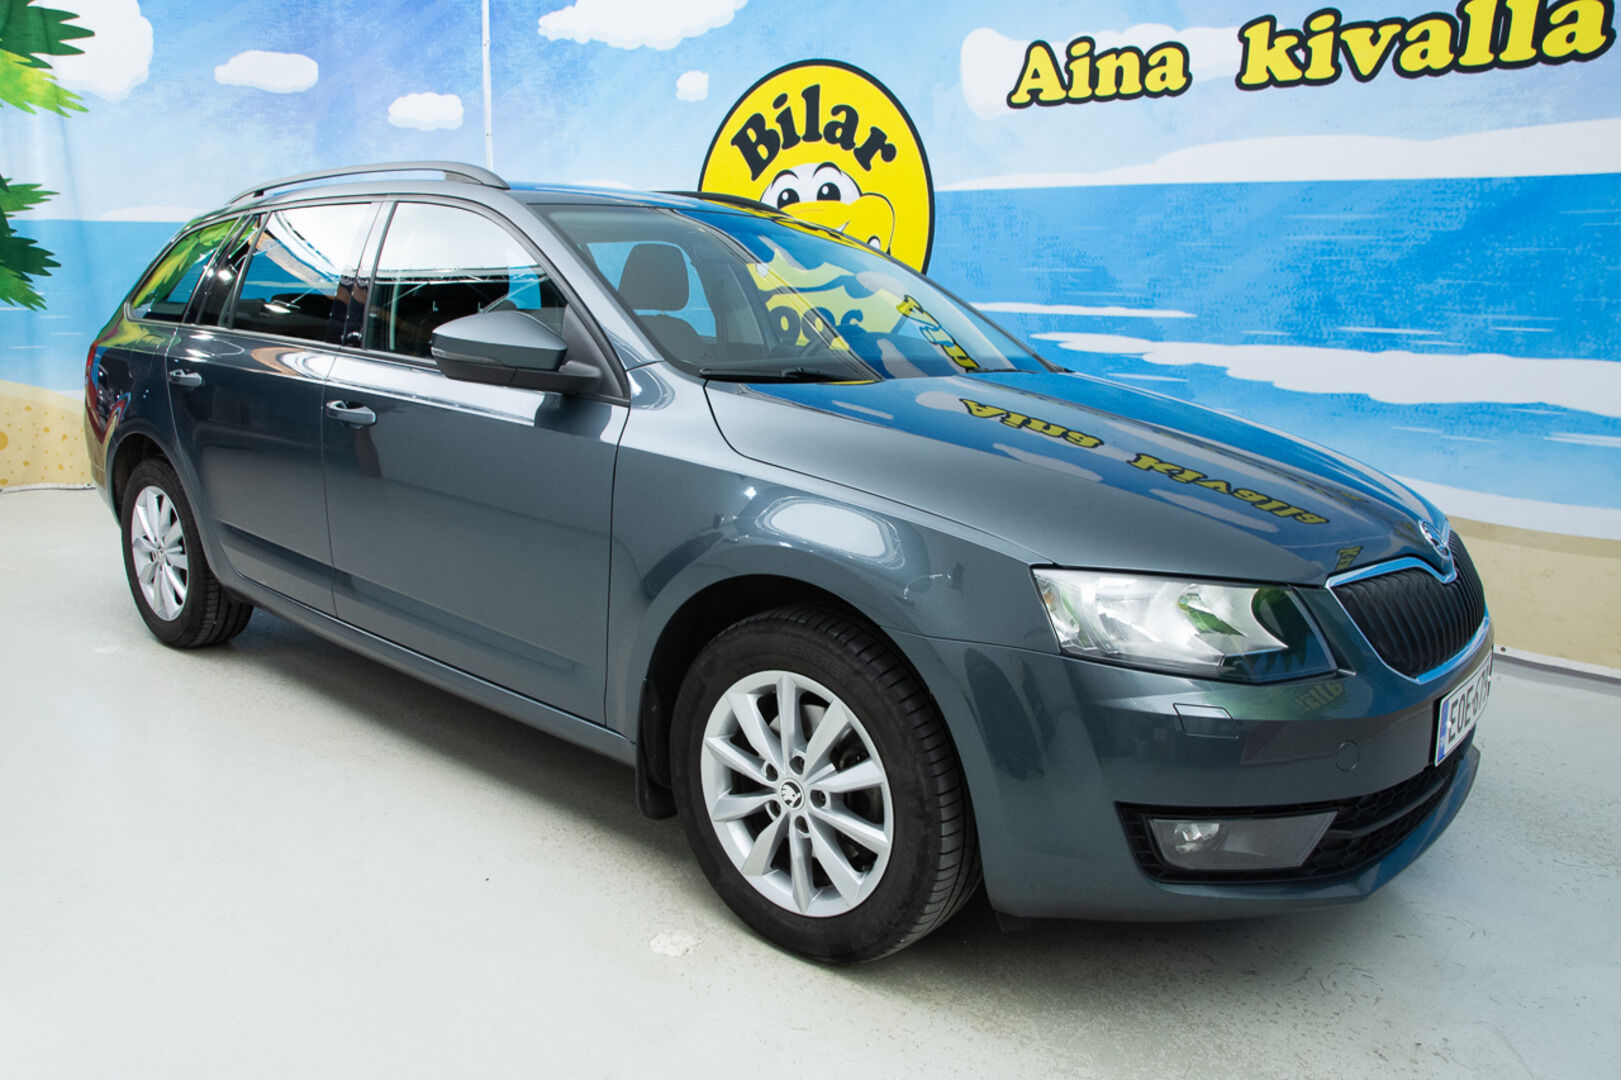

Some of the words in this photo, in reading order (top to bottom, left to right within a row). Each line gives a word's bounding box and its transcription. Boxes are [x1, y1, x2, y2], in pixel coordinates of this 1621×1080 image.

[1006, 36, 1193, 109] Aina
[1236, 0, 1616, 91] kivalla
[730, 83, 897, 182] Bilar
